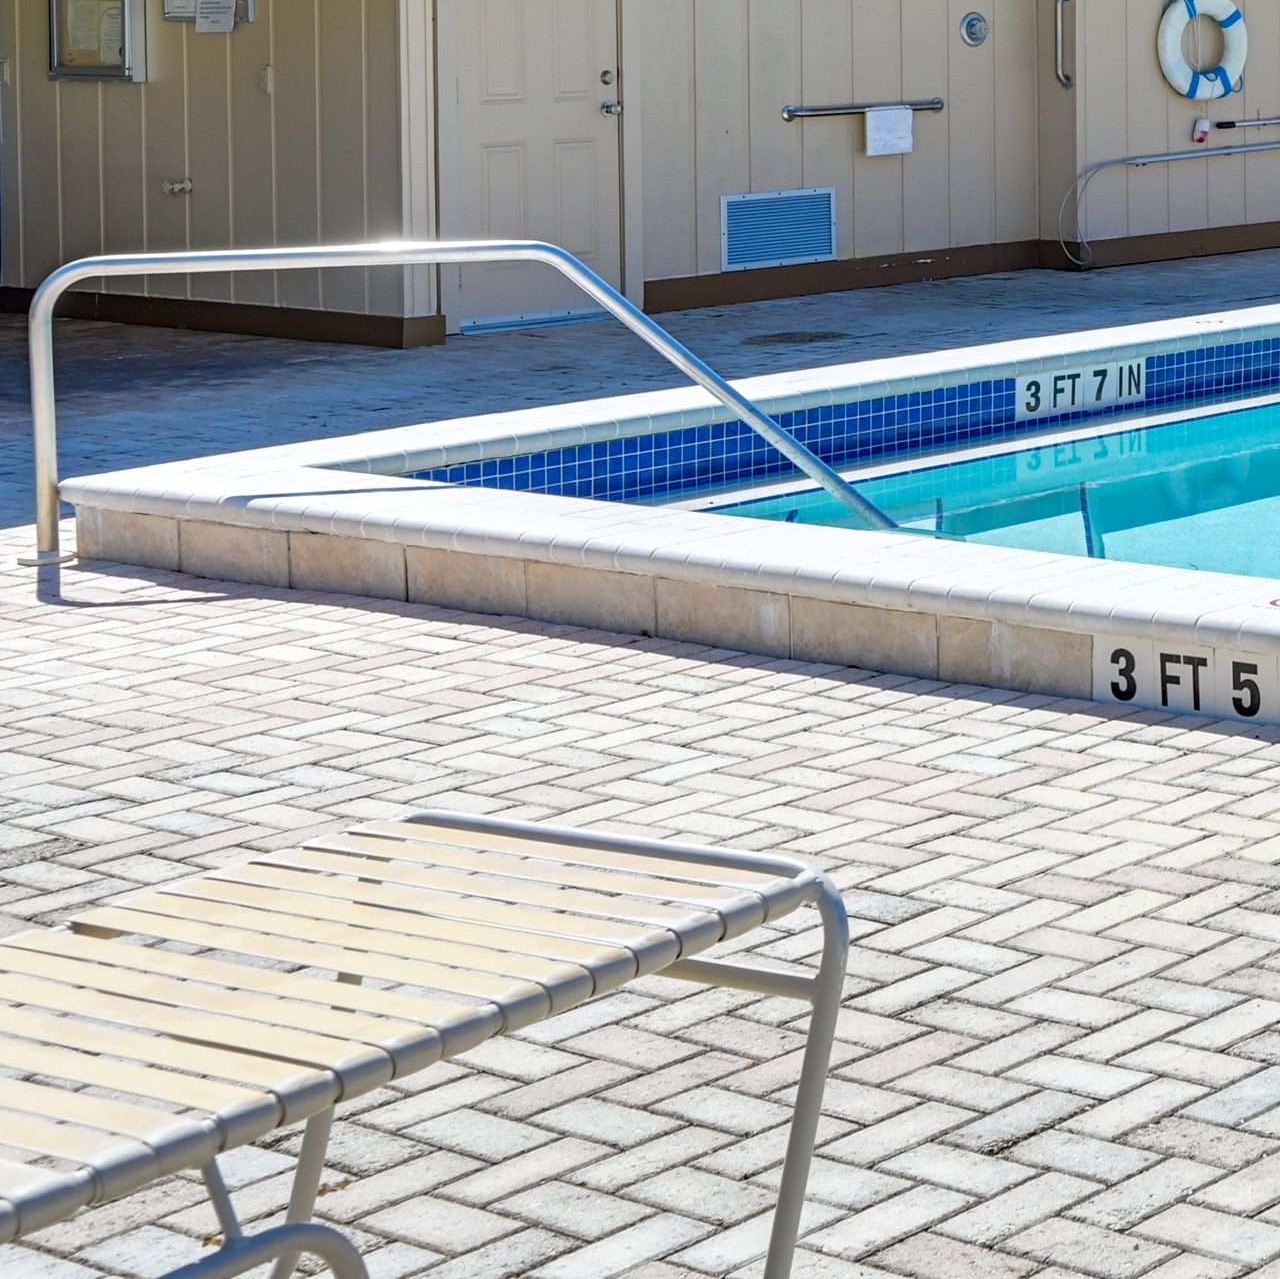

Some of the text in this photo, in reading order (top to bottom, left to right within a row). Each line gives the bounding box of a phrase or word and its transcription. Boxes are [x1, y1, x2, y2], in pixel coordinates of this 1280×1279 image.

[1025, 363, 1142, 413] 3 FT 7 IN
[1109, 648, 1137, 701] 3
[1159, 652, 1208, 711] FT
[1231, 660, 1261, 718] 5
